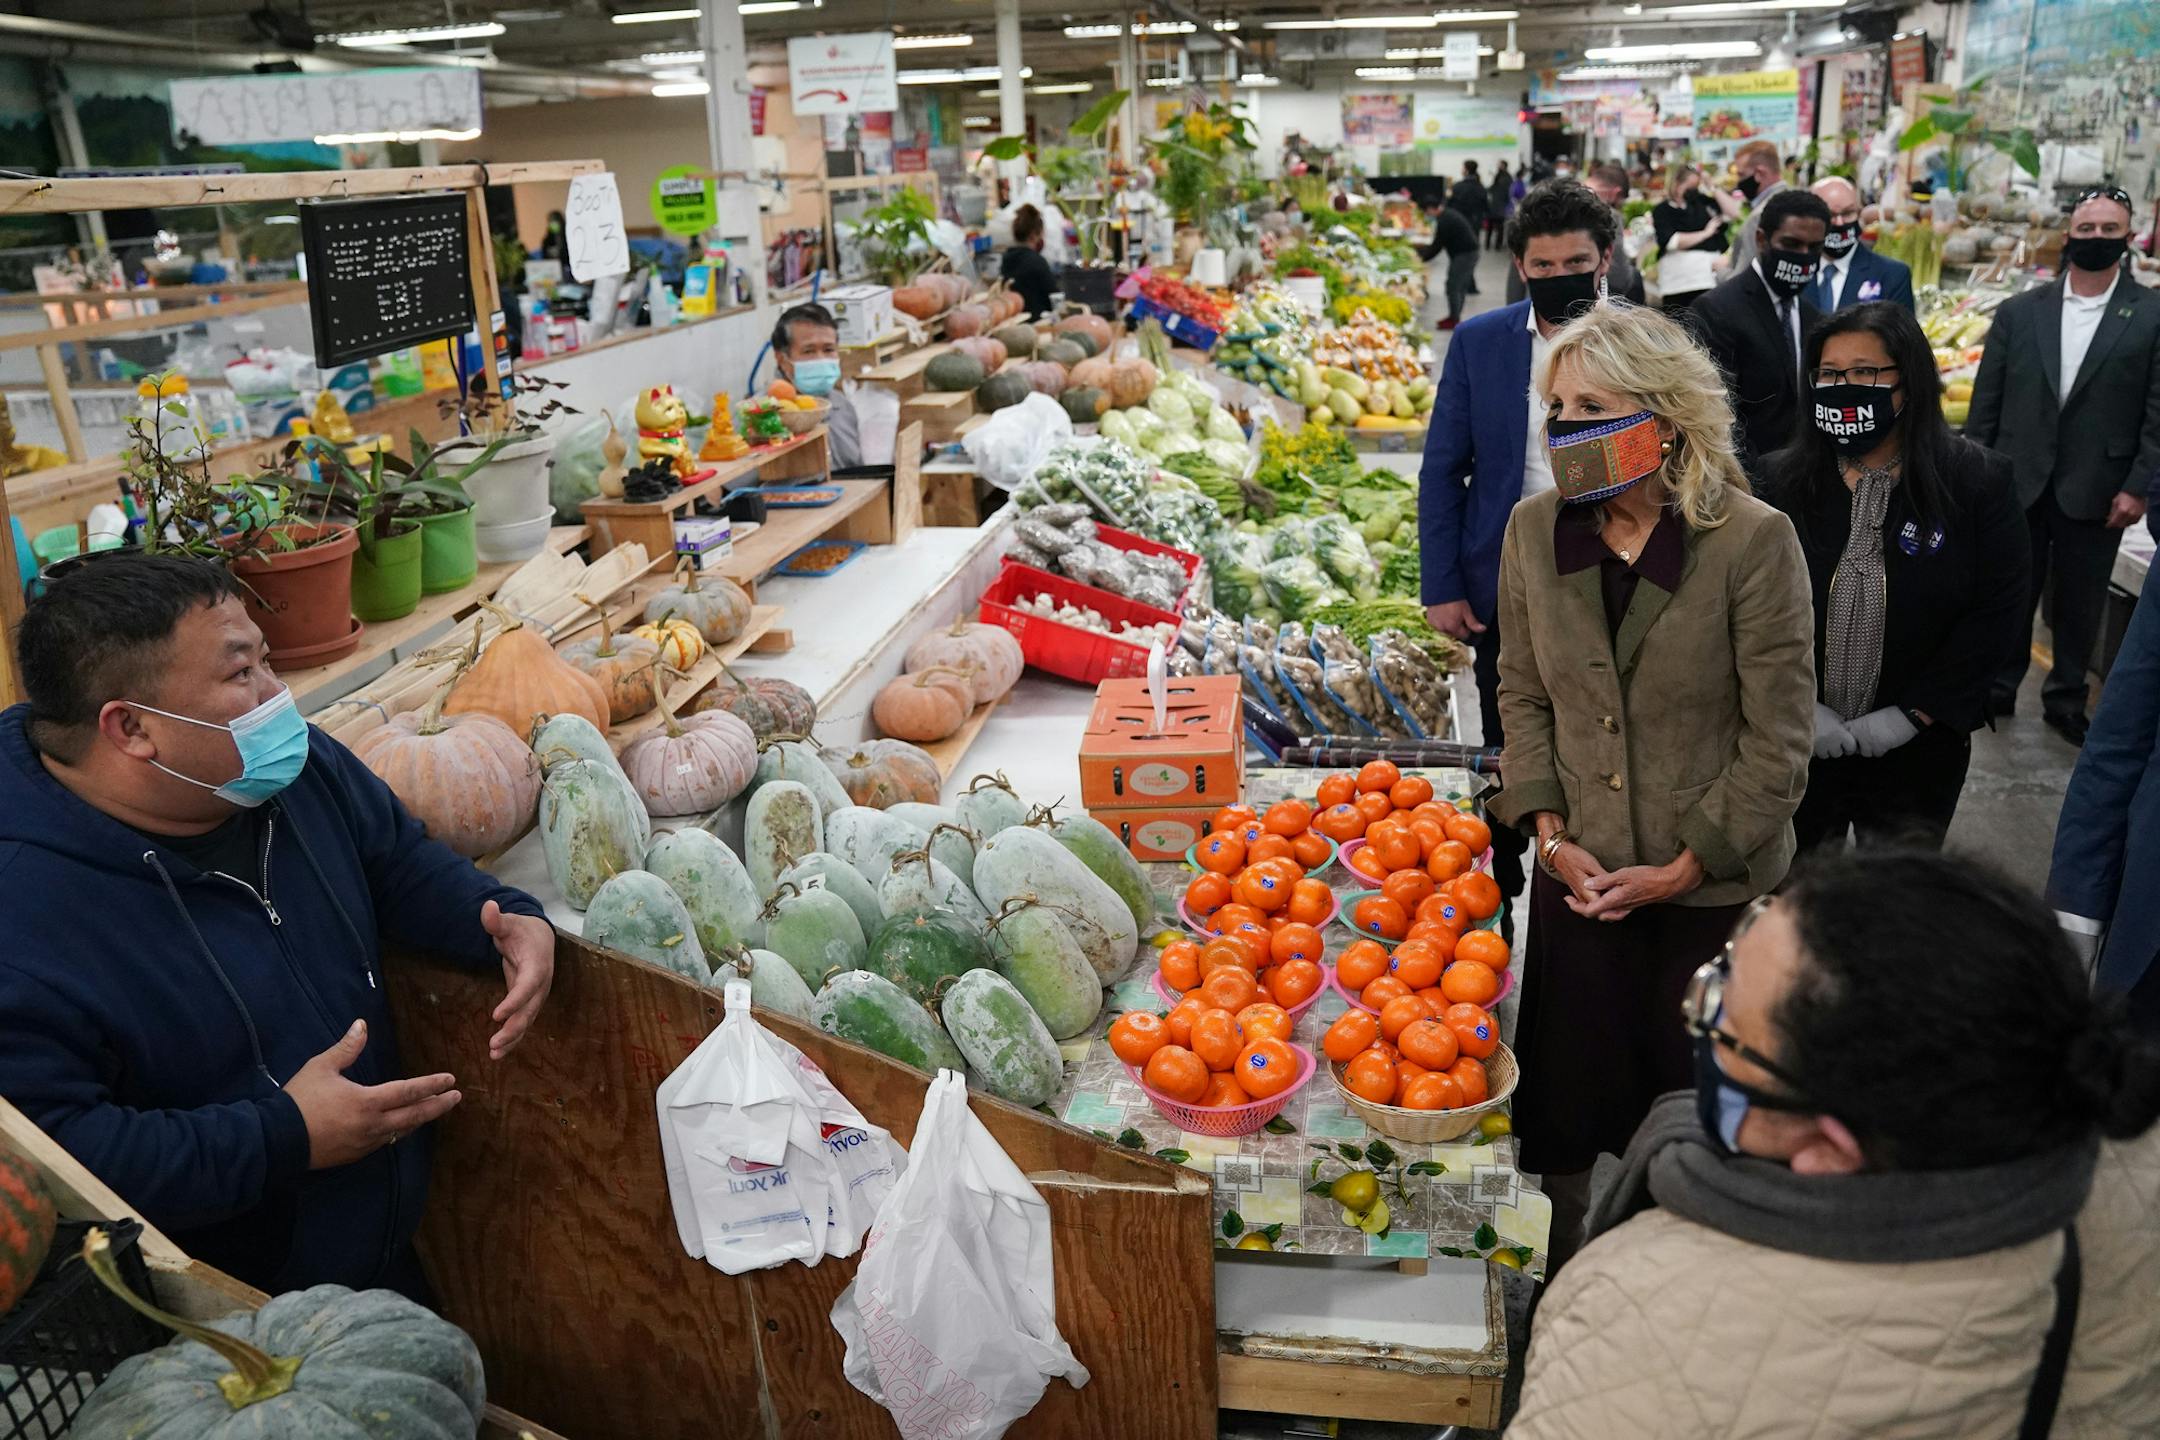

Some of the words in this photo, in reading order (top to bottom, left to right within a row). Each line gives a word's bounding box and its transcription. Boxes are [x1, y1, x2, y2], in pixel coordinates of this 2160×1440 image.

[1815, 403, 1874, 423] BIDEN
[1815, 419, 1876, 436] HARRIS
[1901, 529, 1939, 549] HAIS
[1903, 521, 1943, 542] BIN
